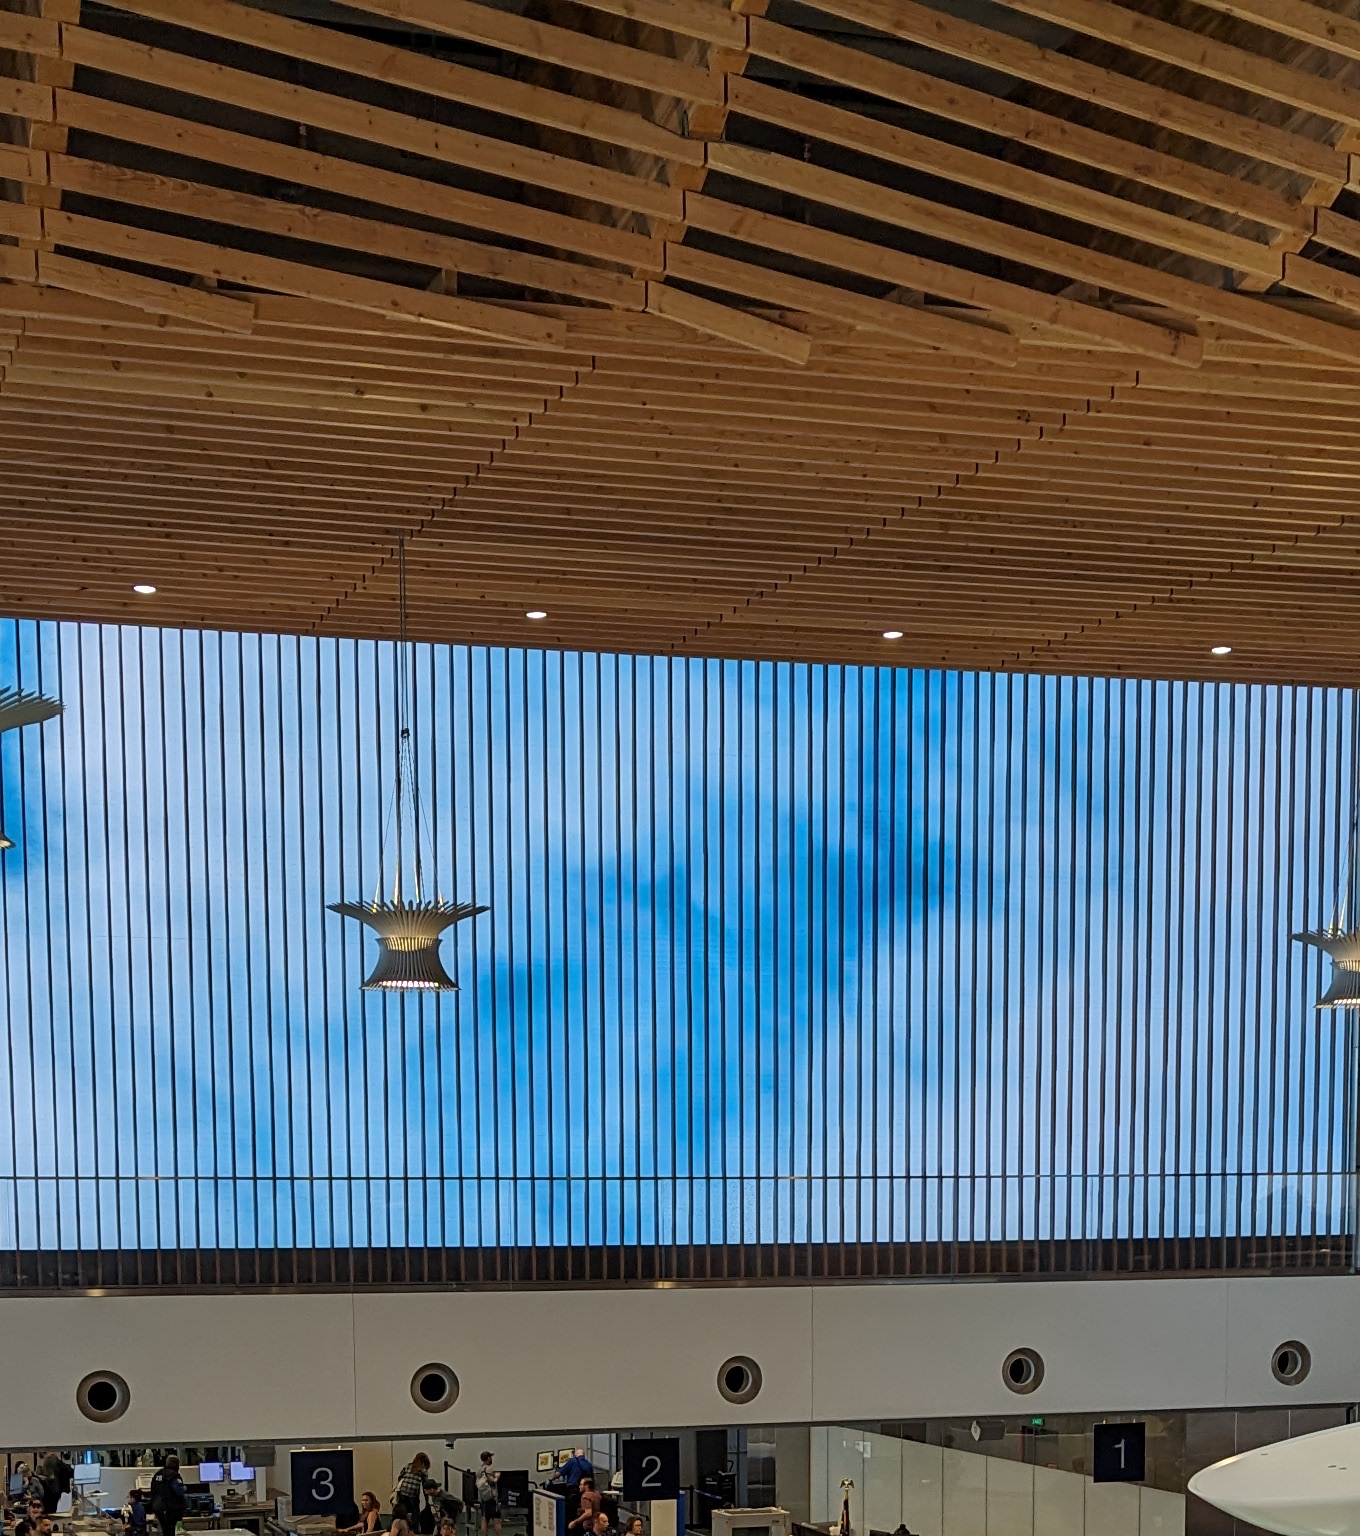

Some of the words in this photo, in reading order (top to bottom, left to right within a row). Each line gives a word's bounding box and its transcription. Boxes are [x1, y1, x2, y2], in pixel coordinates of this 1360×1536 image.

[1114, 1438, 1126, 1469] 1
[311, 1467, 335, 1502] 3
[641, 1455, 662, 1488] 2
